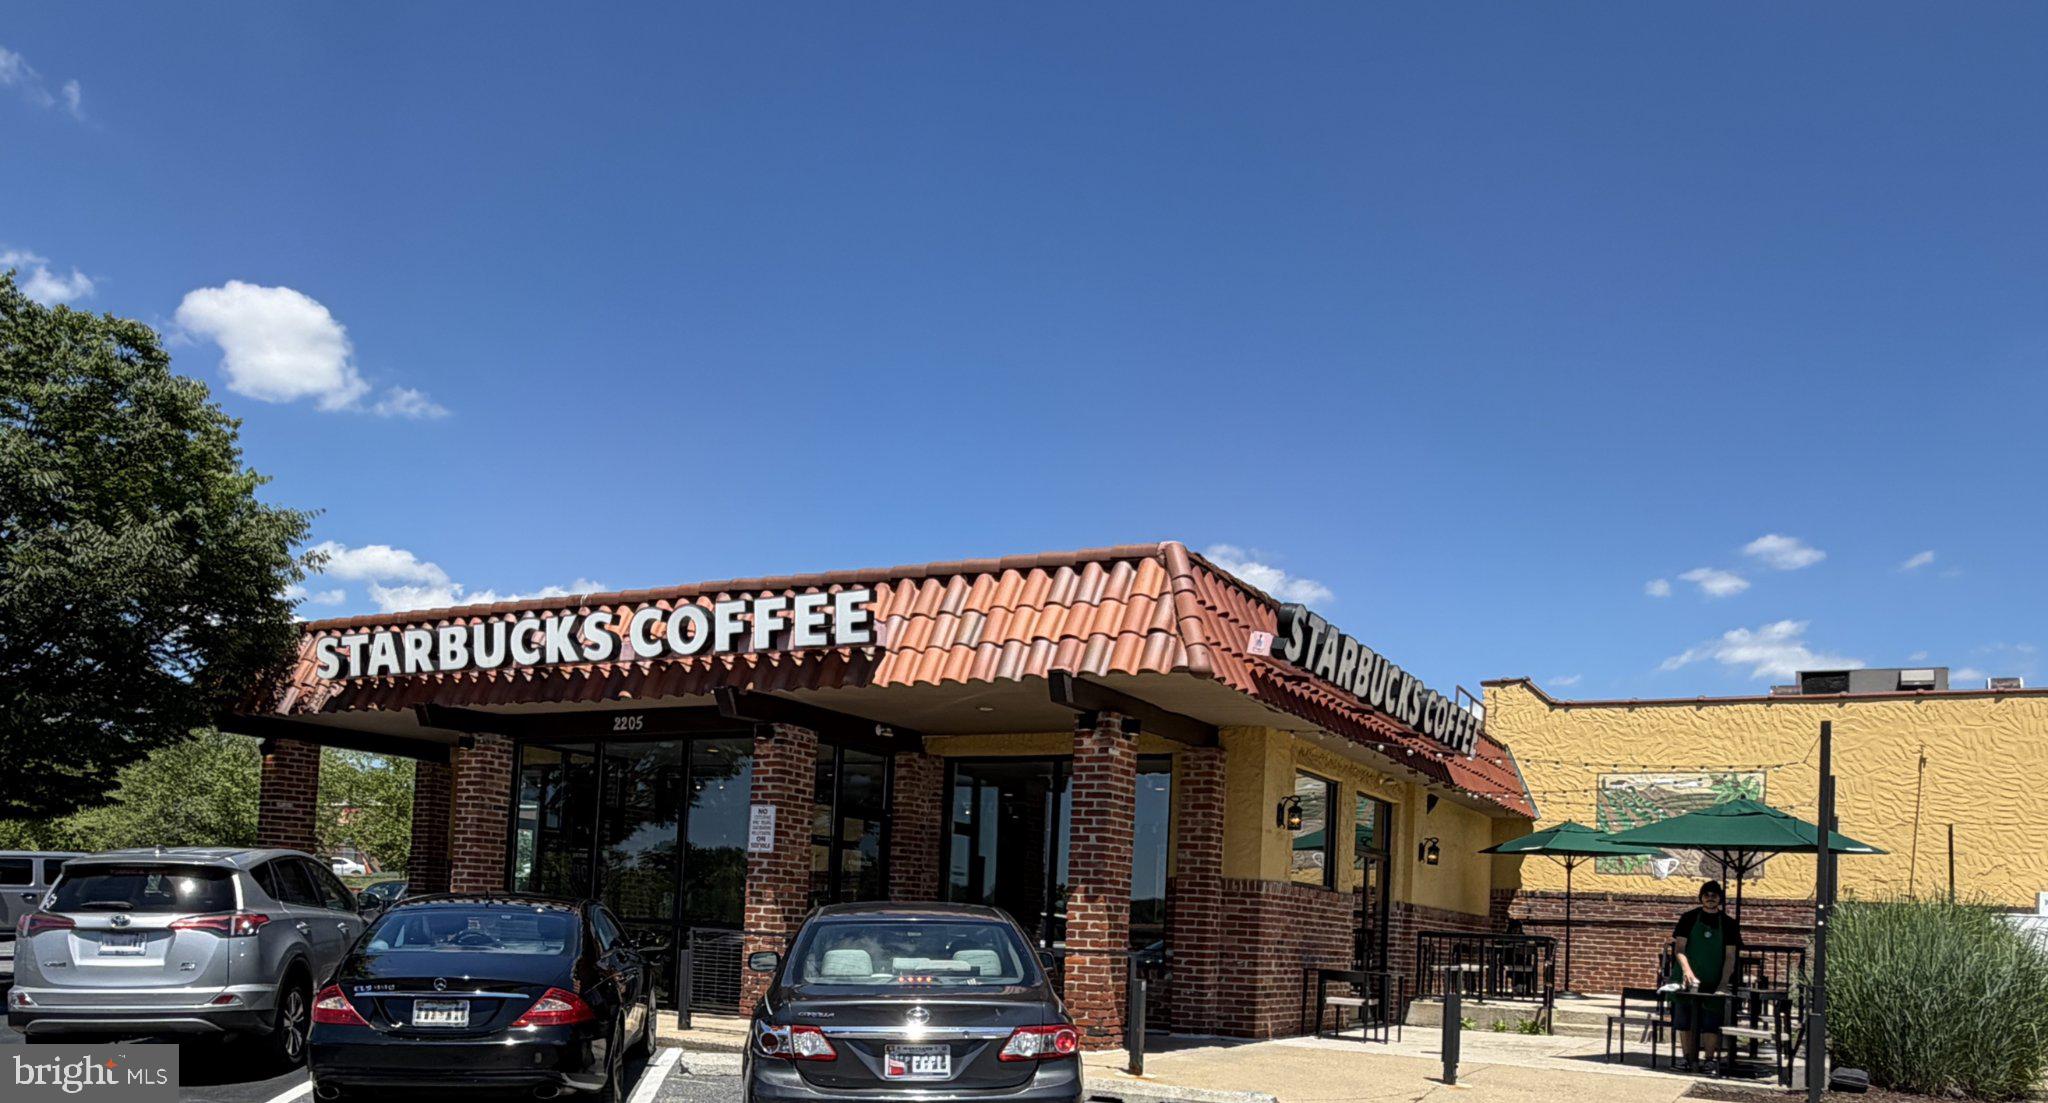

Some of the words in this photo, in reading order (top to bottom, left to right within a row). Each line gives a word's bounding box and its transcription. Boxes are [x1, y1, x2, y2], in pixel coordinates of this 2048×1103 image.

[316, 611, 613, 680] STARBUCKS
[629, 589, 870, 658] COFFEE
[1281, 603, 1424, 727] STARBUCKS
[613, 715, 644, 731] 2205
